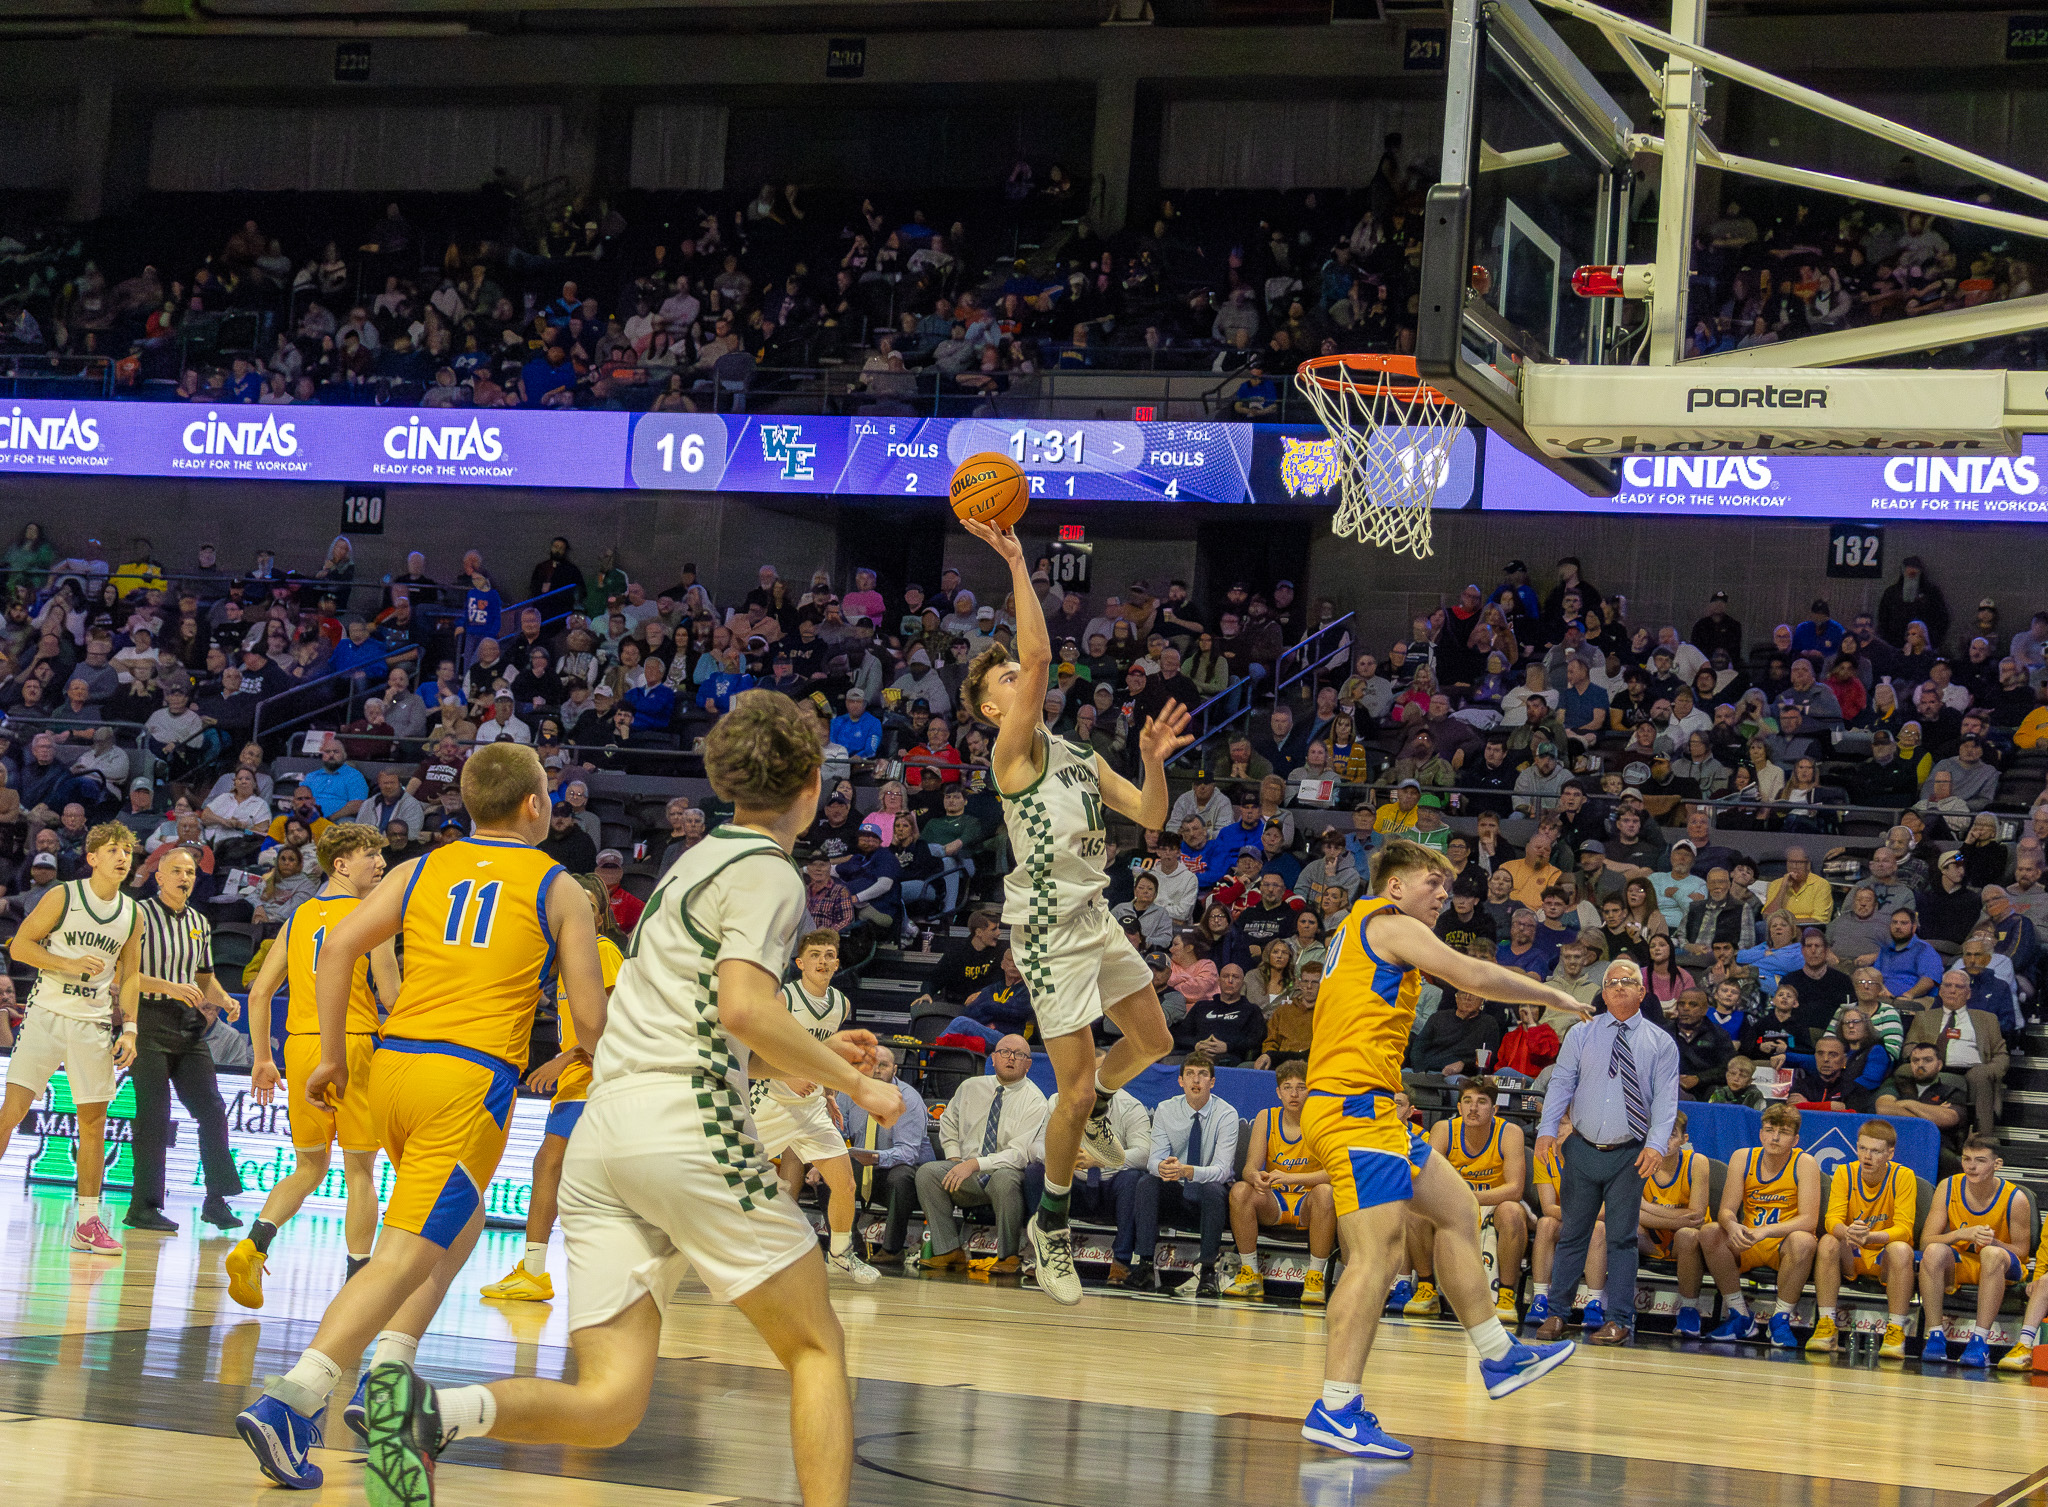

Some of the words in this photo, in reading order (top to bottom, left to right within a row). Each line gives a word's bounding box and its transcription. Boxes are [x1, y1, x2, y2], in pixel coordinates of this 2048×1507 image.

[1136, 407, 1153, 421] EXIT
[183, 411, 297, 457] CINTAS
[383, 415, 503, 462] CINTAS
[889, 425, 896, 435] 5
[657, 433, 705, 473] 16
[887, 443, 939, 458] FOULS
[1010, 429, 1085, 463] 1:31
[13, 454, 34, 465] FOR
[37, 455, 56, 466] THE
[59, 456, 109, 467] WORKDAY
[172, 458, 206, 469] READY
[209, 459, 230, 470] FOR
[234, 460, 253, 470] THE
[256, 461, 308, 472] WORKDAY
[1151, 451, 1204, 467] FOULS
[373, 464, 408, 474] READY
[412, 464, 432, 475] FOR
[437, 465, 456, 475] THE
[459, 466, 514, 477] WORKDAY
[1623, 456, 1772, 490] CINTAS
[1884, 456, 2039, 495] CINTAS
[905, 473, 918, 493] 2
[951, 469, 998, 498] Wilson
[1065, 476, 1075, 496] 1
[1164, 479, 1179, 499] 4
[1612, 493, 1654, 504] READY
[1659, 493, 1685, 505] FOR
[1690, 494, 1714, 506] THE
[1718, 495, 1786, 507] WORKDAY
[1871, 498, 1917, 509] READY
[1921, 499, 1949, 510] FOR
[1954, 500, 1979, 511] THE
[1984, 500, 2048, 512] WORKDA
[346, 497, 382, 524] 130
[1064, 525, 1081, 540] EXIT
[1833, 536, 1879, 567] 132
[1051, 553, 1087, 582] 131
[443, 879, 503, 949] 11
[1272, 1152, 1309, 1171] Logan
[1753, 1206, 1782, 1226] 34
